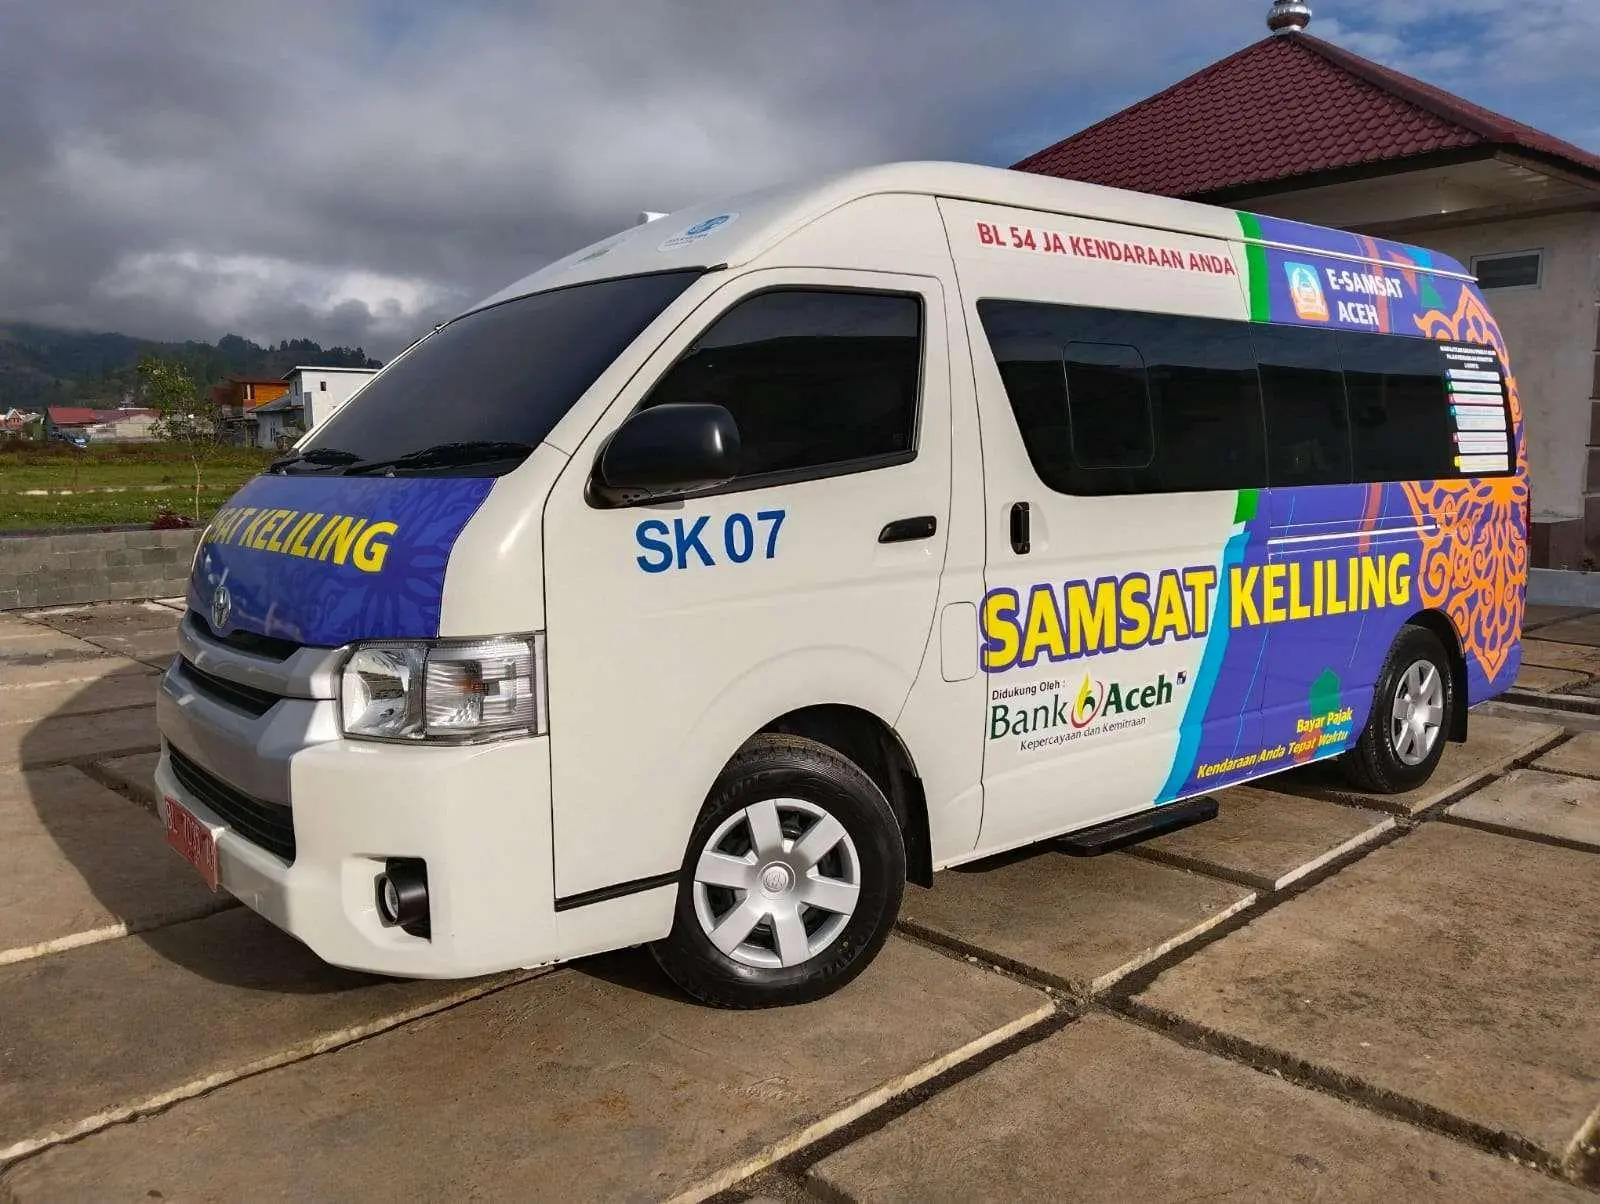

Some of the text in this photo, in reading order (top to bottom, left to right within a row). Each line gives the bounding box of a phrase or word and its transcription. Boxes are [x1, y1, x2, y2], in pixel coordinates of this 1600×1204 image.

[977, 223, 1235, 275] BL 54 JA KENDARAAN ANDA
[1326, 268, 1404, 298] E-SAMSAT
[1338, 301, 1380, 326] ACEH
[239, 509, 399, 572] KELILING
[635, 509, 786, 573] SK 07
[981, 552, 1411, 671] SAMSAT KELILING
[990, 675, 1173, 740] Bank Aceh
[992, 683, 1037, 700] Didukung
[1039, 679, 1061, 692] Oleh
[1020, 717, 1146, 751] Kepercayaan dan Kemitraan
[1296, 707, 1353, 733] Bayar Pajak
[1197, 730, 1348, 779] Kendaraan Anda Tepat Waktu
